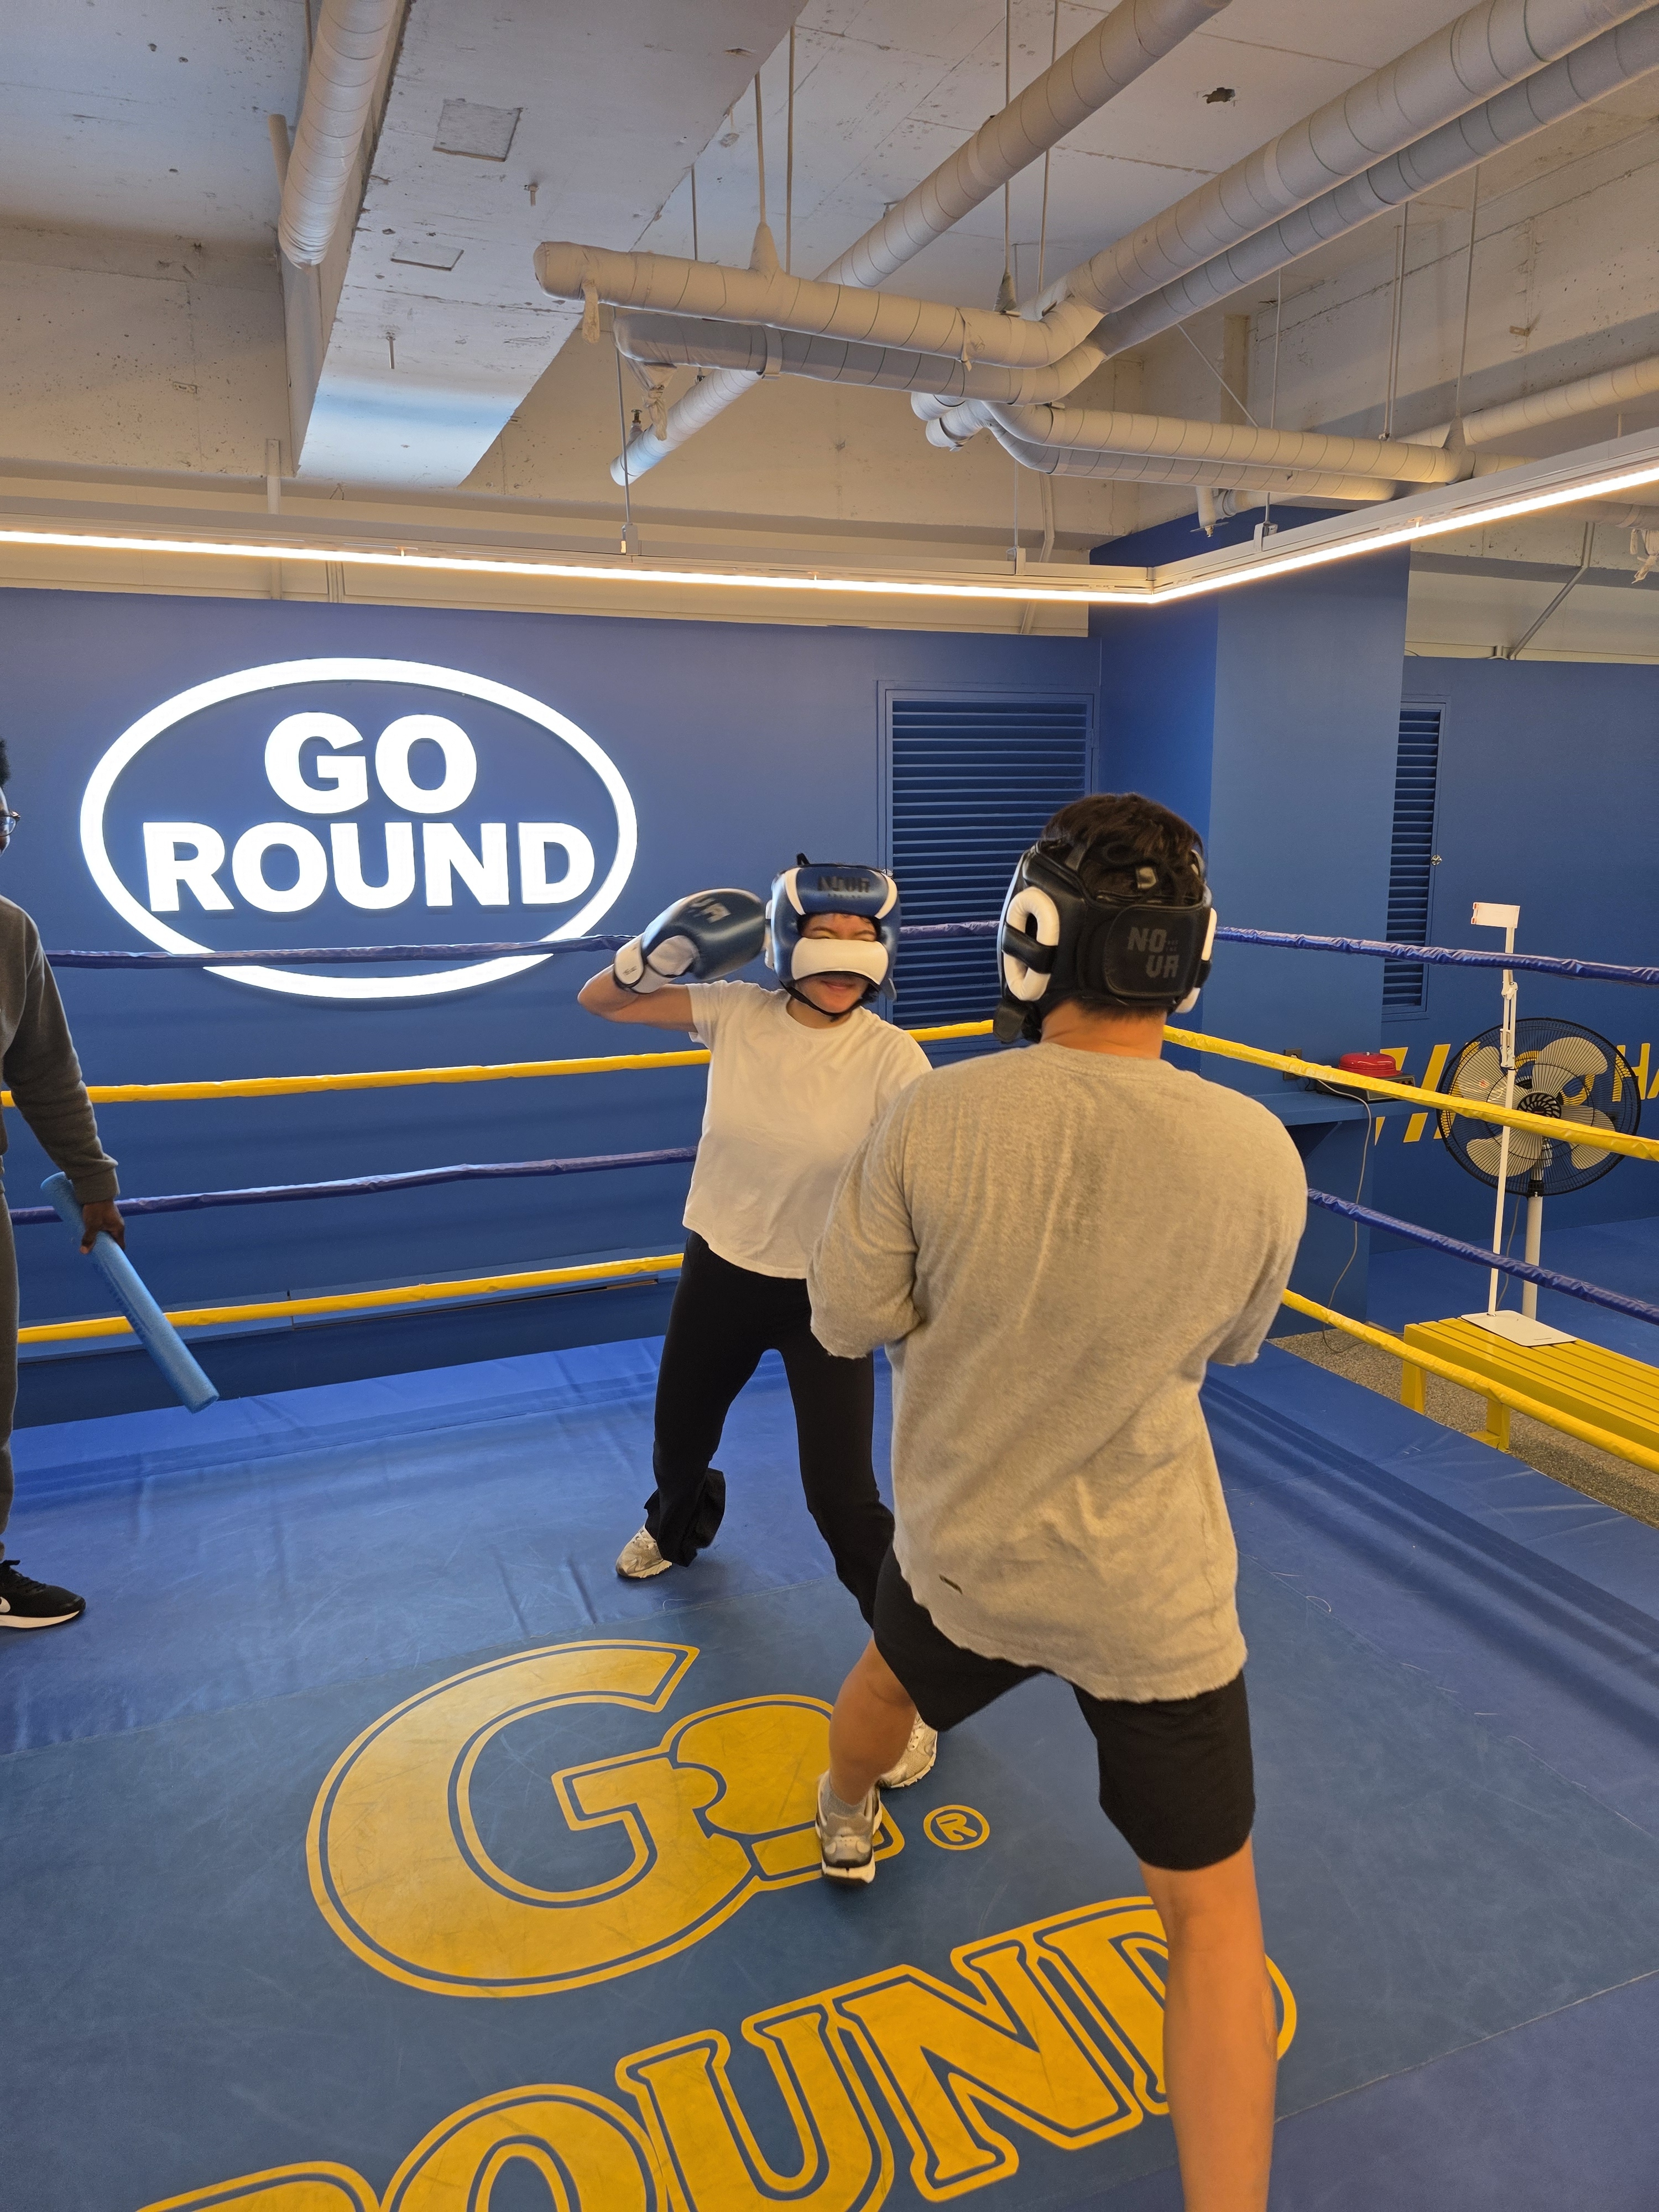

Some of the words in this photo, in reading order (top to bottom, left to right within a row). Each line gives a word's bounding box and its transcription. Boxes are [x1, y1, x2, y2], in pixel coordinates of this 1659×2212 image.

[265, 711, 477, 815] GO
[143, 821, 595, 912] ROUND
[1128, 927, 1167, 952] NO
[134, 1896, 1297, 2212] OUND
